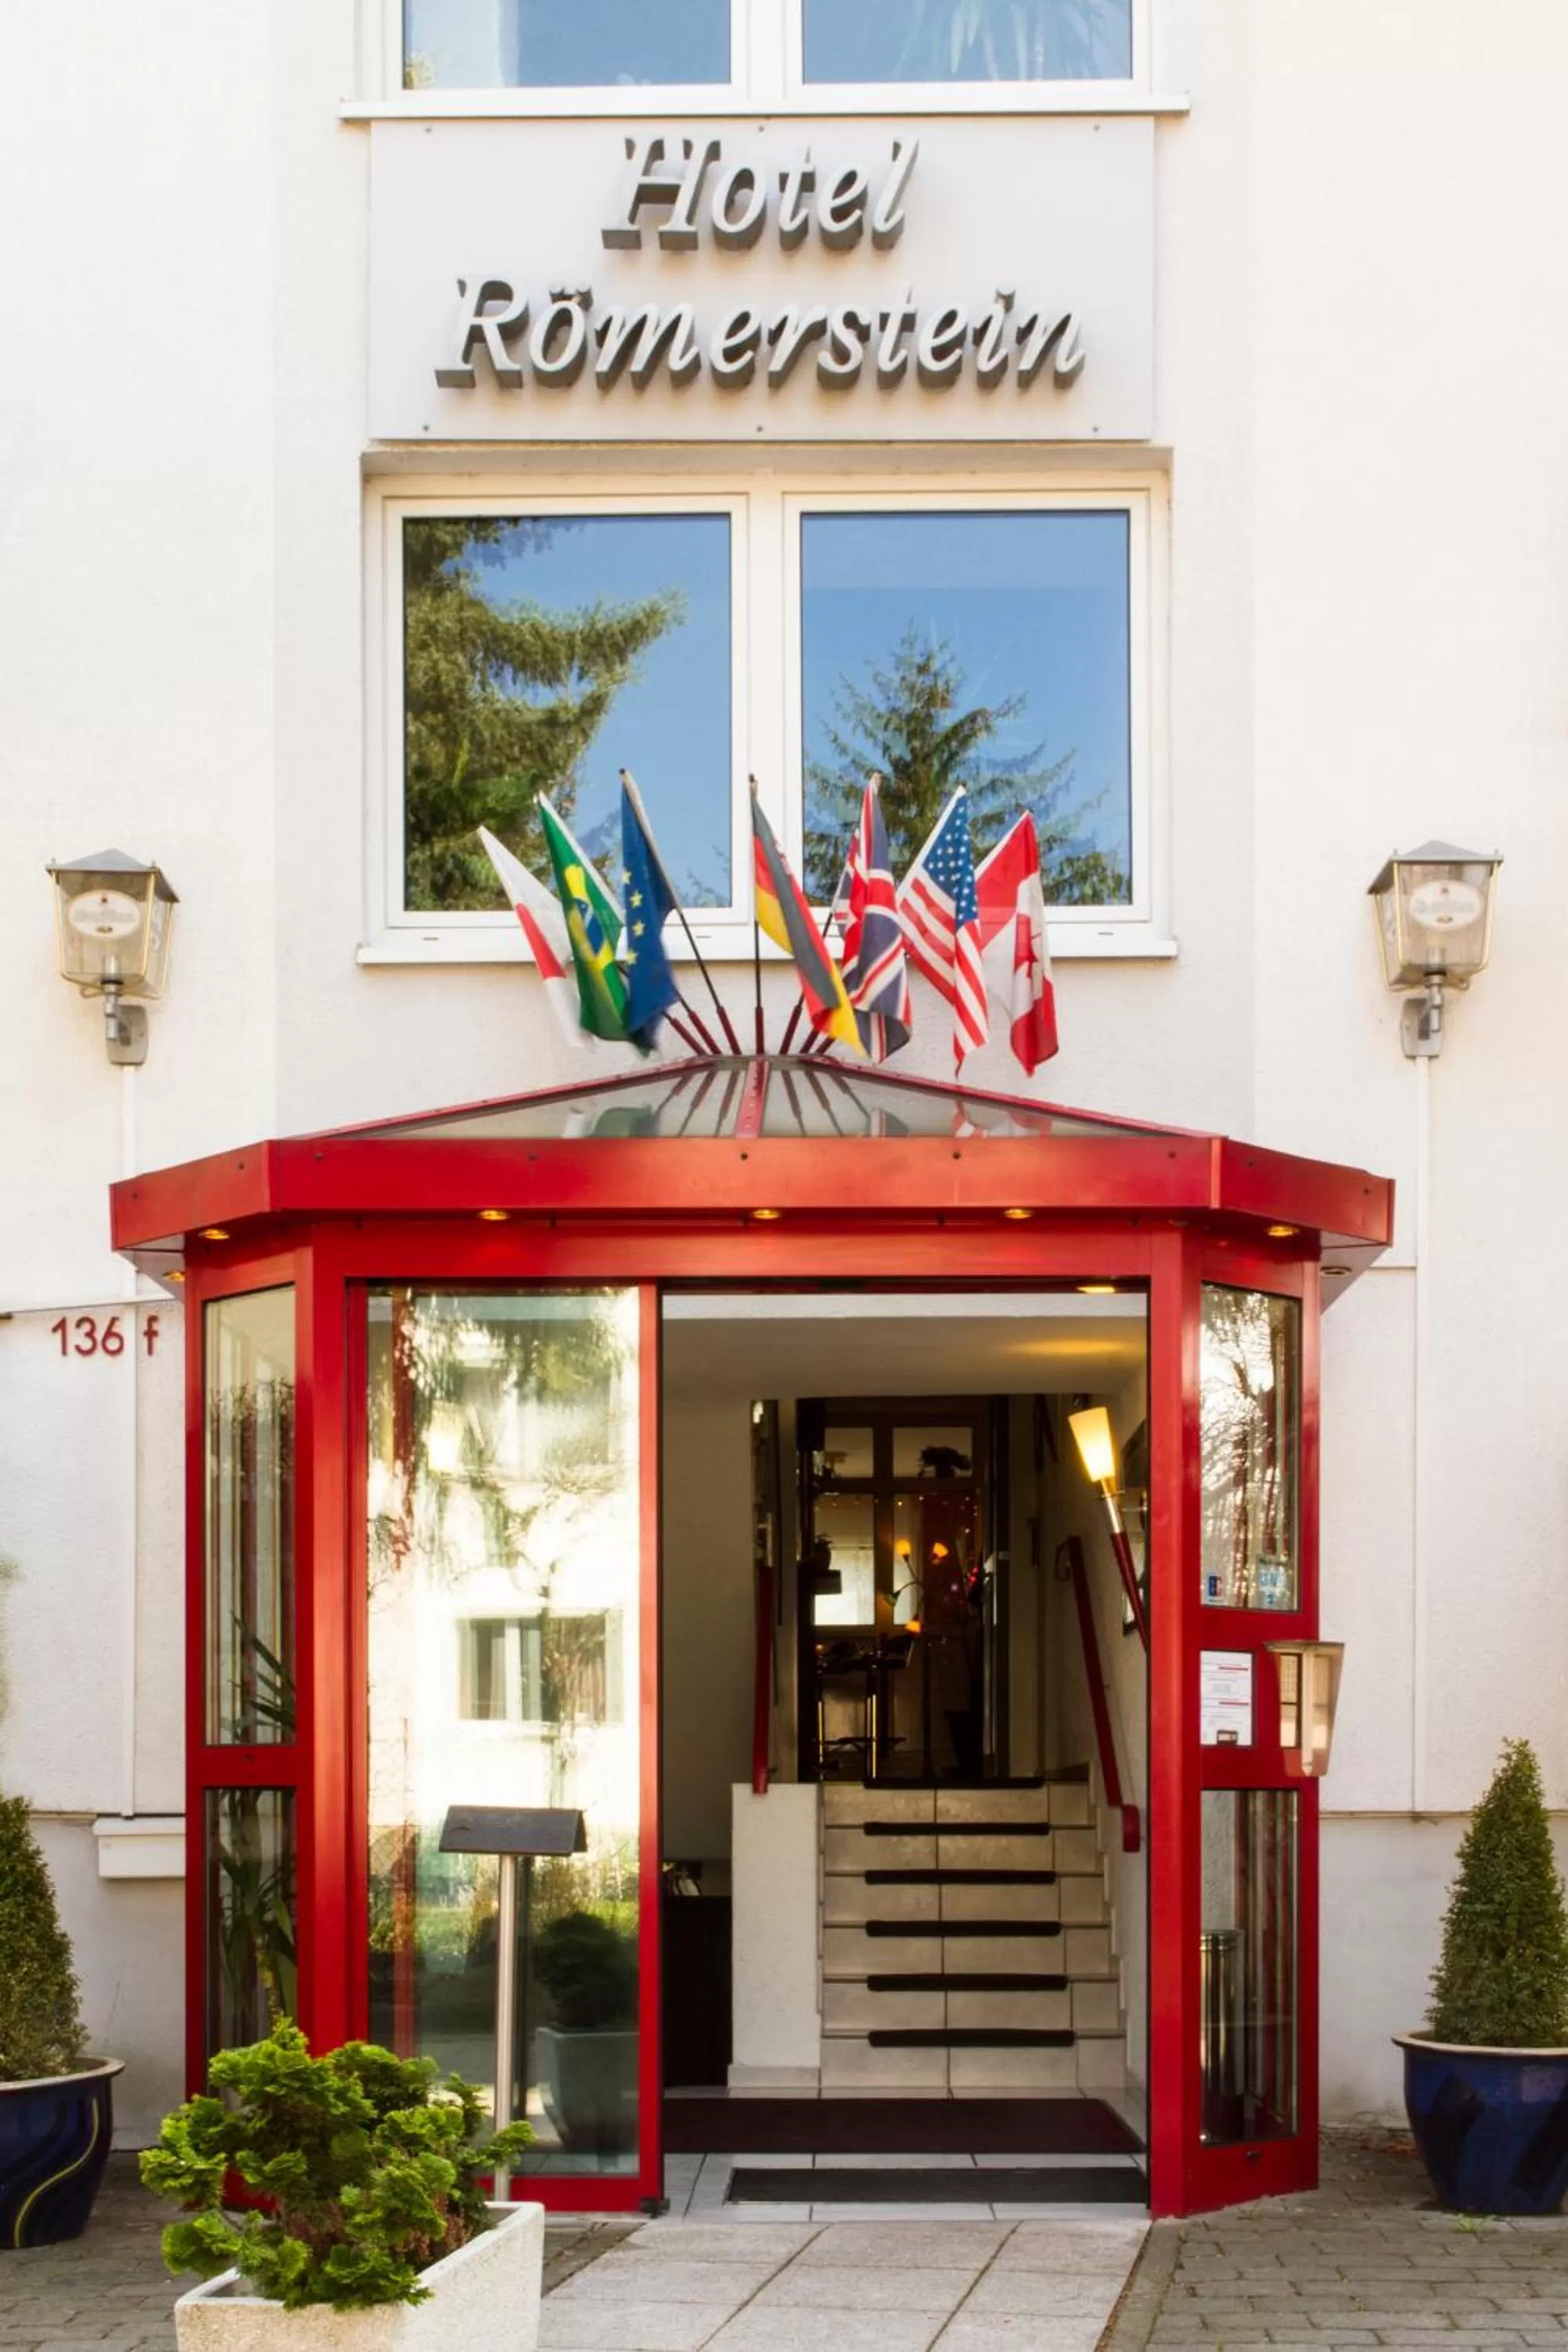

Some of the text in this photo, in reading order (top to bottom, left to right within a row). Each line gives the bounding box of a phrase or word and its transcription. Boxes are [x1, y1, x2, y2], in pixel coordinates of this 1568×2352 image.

[601, 136, 919, 250] Hotel
[434, 278, 1086, 390] Römerstein
[51, 1315, 159, 1356] 136 f
